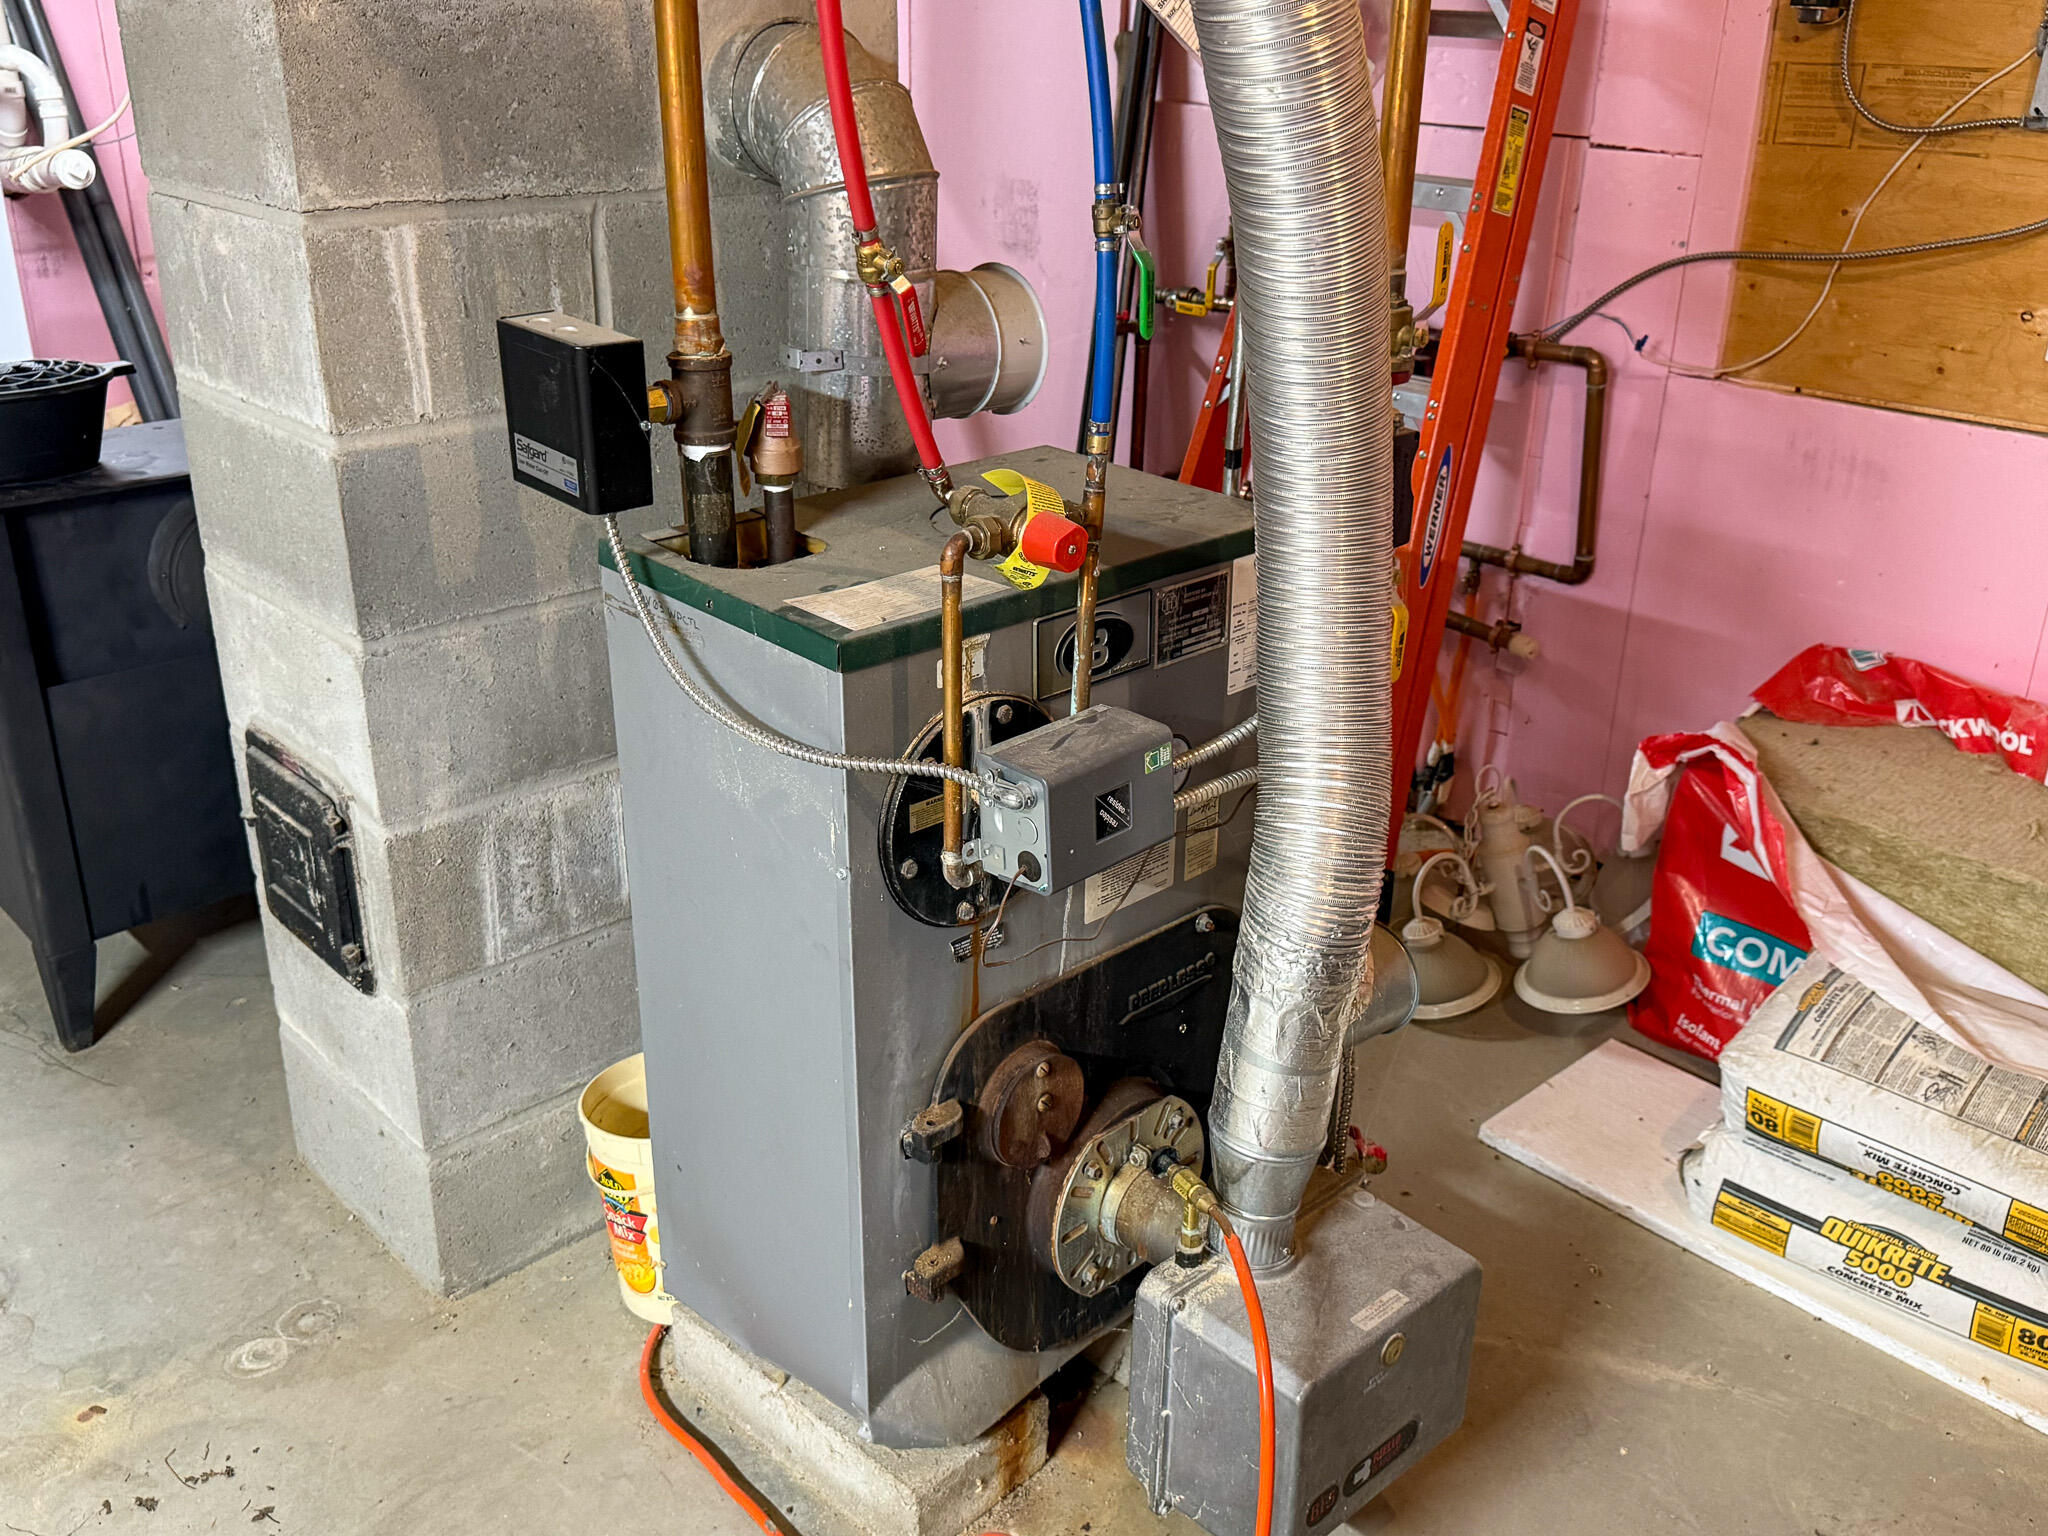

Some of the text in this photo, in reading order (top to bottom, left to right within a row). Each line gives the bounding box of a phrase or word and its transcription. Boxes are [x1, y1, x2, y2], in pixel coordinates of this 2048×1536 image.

[517, 439, 547, 463] Safgard
[1424, 475, 1447, 557] WERNER
[1106, 795, 1127, 814] resideo
[1676, 1012, 1721, 1051] Isolant
[1750, 1110, 1780, 1133] 80
[1863, 1149, 1890, 1167] MIX
[1876, 1170, 1946, 1206] 5000
[1893, 1161, 1961, 1196] CONCRETE
[613, 1223, 636, 1241] Mix
[1847, 1219, 1938, 1261] COMMERCIAL GRADE
[1961, 1236, 1979, 1248] NET
[1844, 1249, 1914, 1288] 5000
[1826, 1265, 1893, 1298] CONCRETE
[1895, 1294, 1923, 1311] MIX
